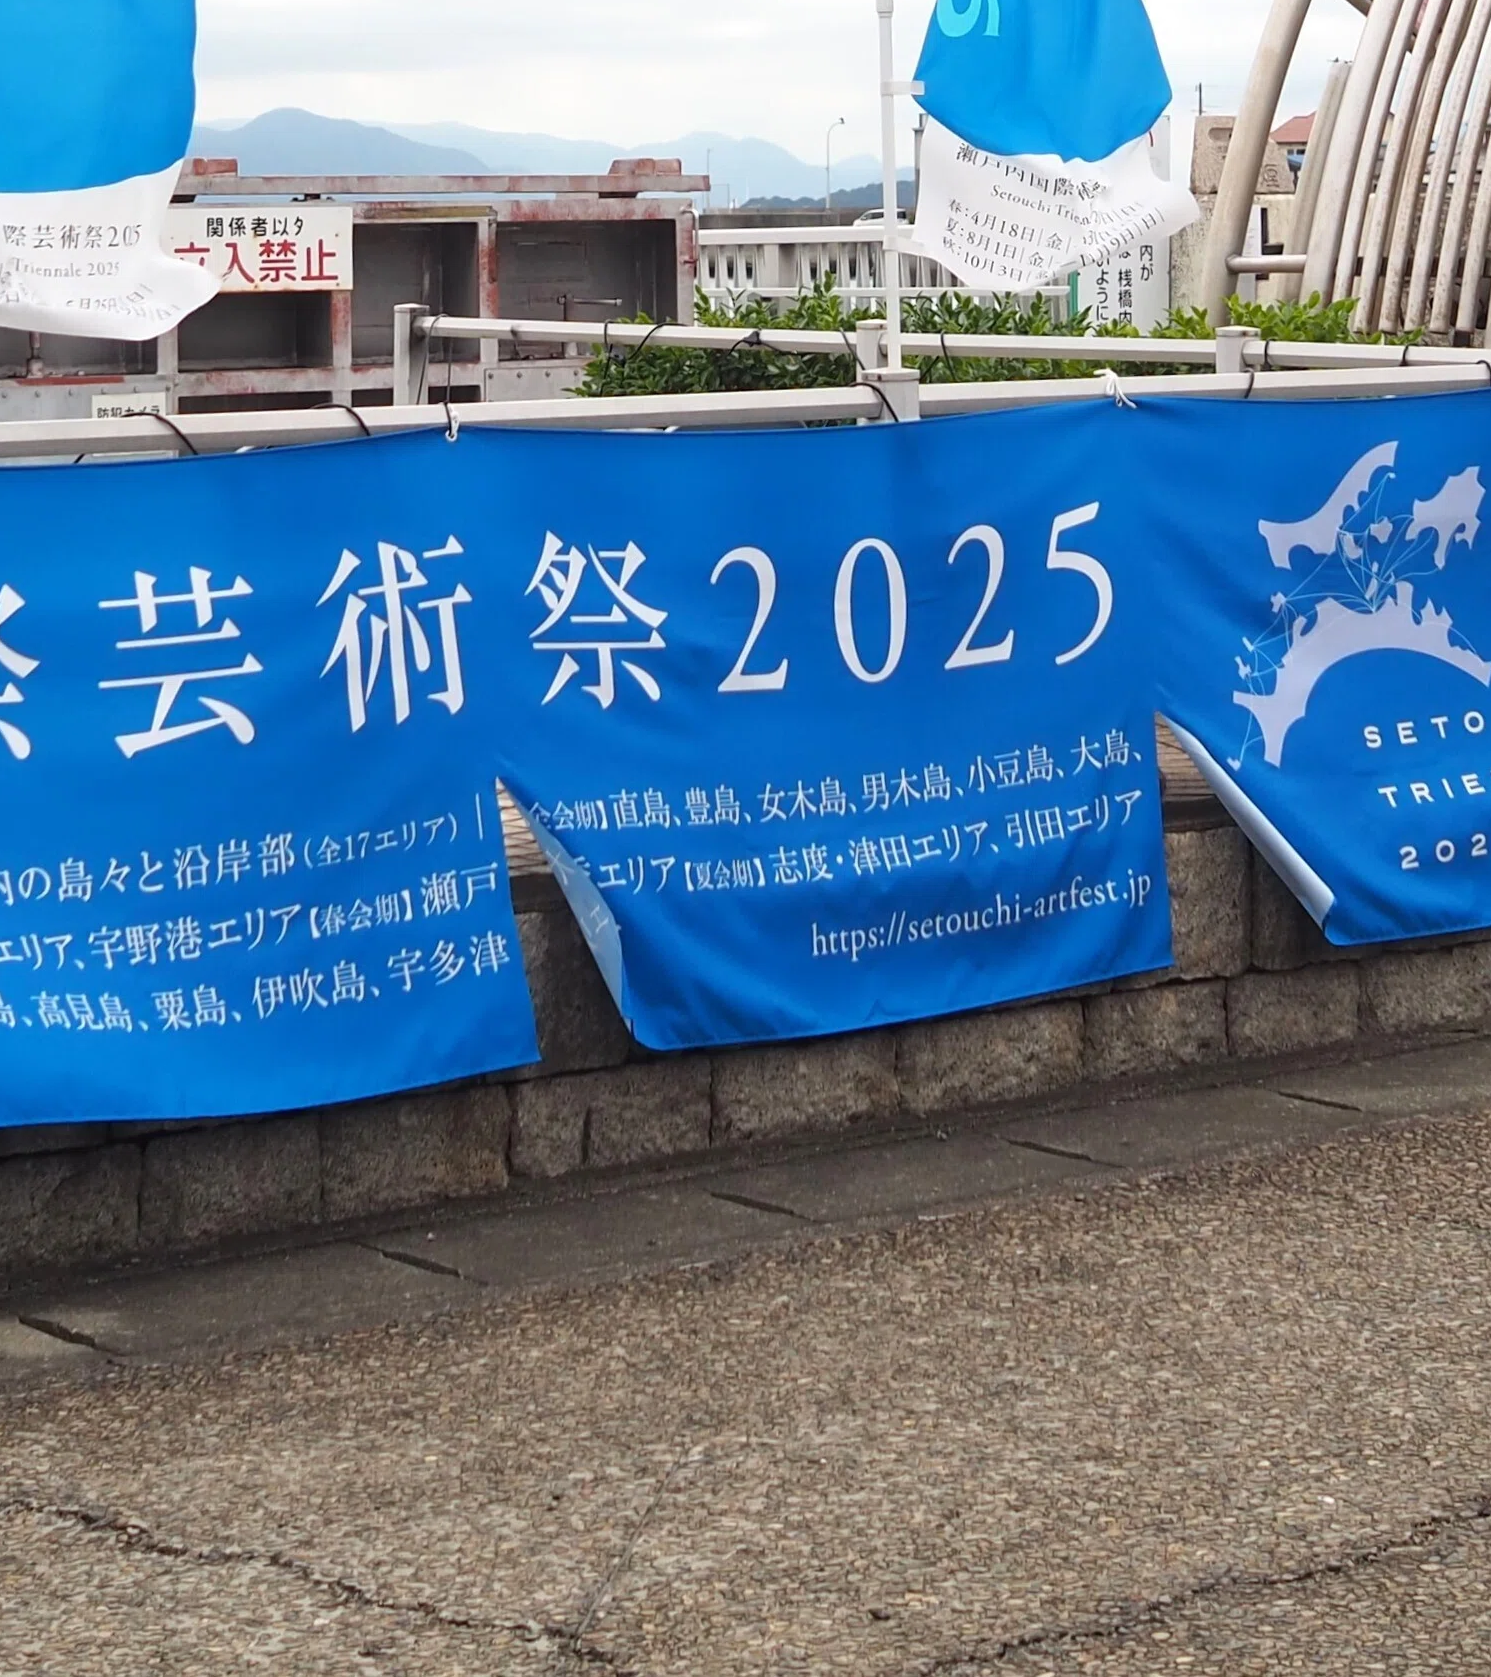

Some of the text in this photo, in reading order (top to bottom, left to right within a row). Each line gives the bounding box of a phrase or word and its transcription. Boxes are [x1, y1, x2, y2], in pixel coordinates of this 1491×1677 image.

[174, 239, 339, 284] 立入禁止
[811, 869, 1152, 963] https://setouchi-artfest.jp
